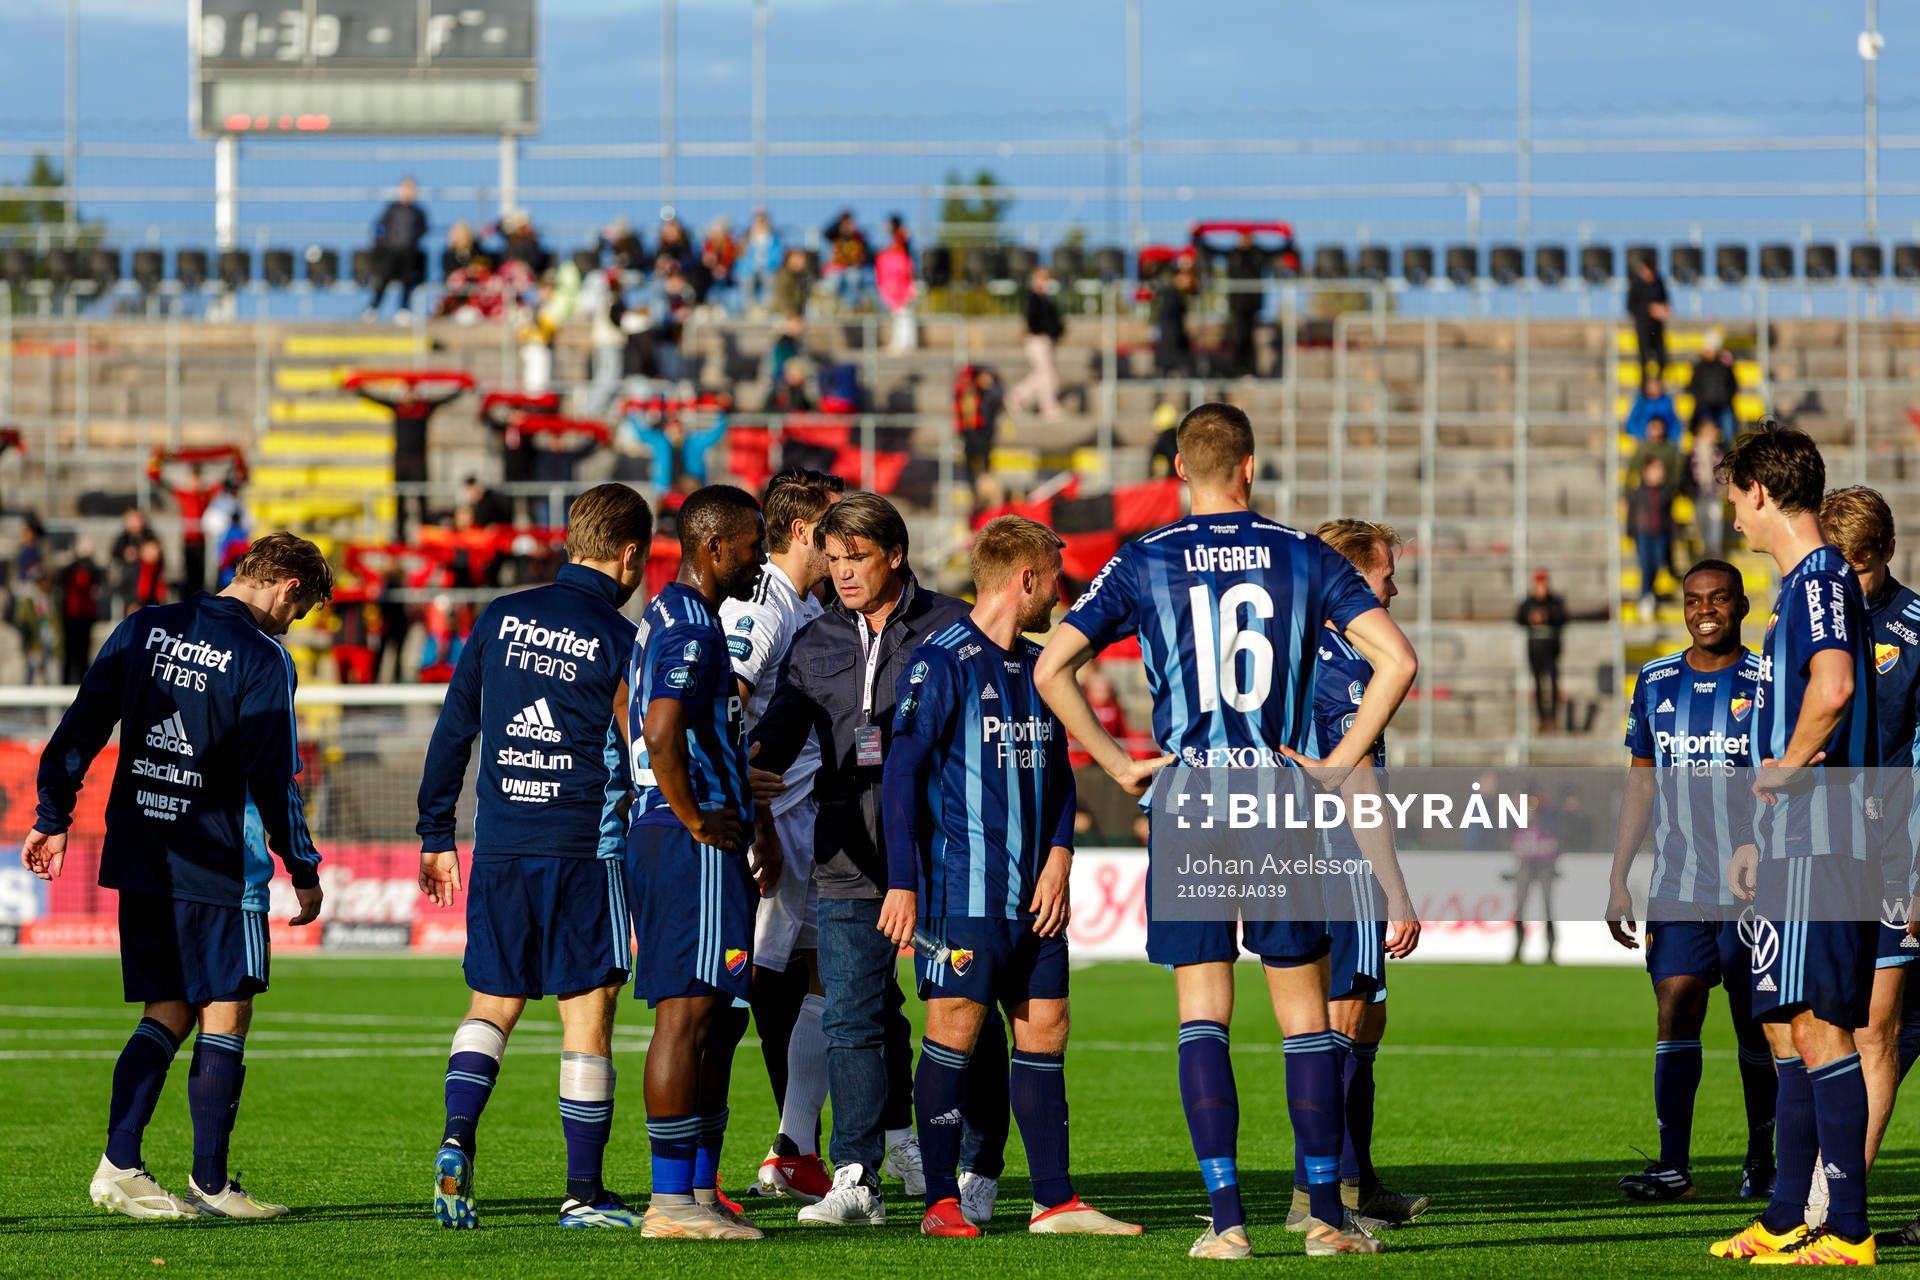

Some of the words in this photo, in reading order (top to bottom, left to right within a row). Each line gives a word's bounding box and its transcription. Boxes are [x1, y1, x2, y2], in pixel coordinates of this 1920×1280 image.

[1184, 544, 1271, 572] LÖFGREN
[145, 627, 233, 673] Prioritet
[498, 615, 600, 661] Prioritet
[1189, 582, 1274, 713] 16
[151, 652, 208, 692] Finans
[505, 641, 577, 682] Finans
[506, 722, 562, 742] adidas
[983, 716, 1053, 742] Prioritet
[146, 732, 194, 757] adidas
[997, 743, 1046, 769] Finans
[1656, 731, 1750, 755] Prioritet
[497, 746, 573, 769] stadium
[1670, 754, 1736, 777] Finans
[132, 757, 203, 788] stadium
[501, 777, 560, 797] UNIBET
[136, 789, 191, 813] UNIBET
